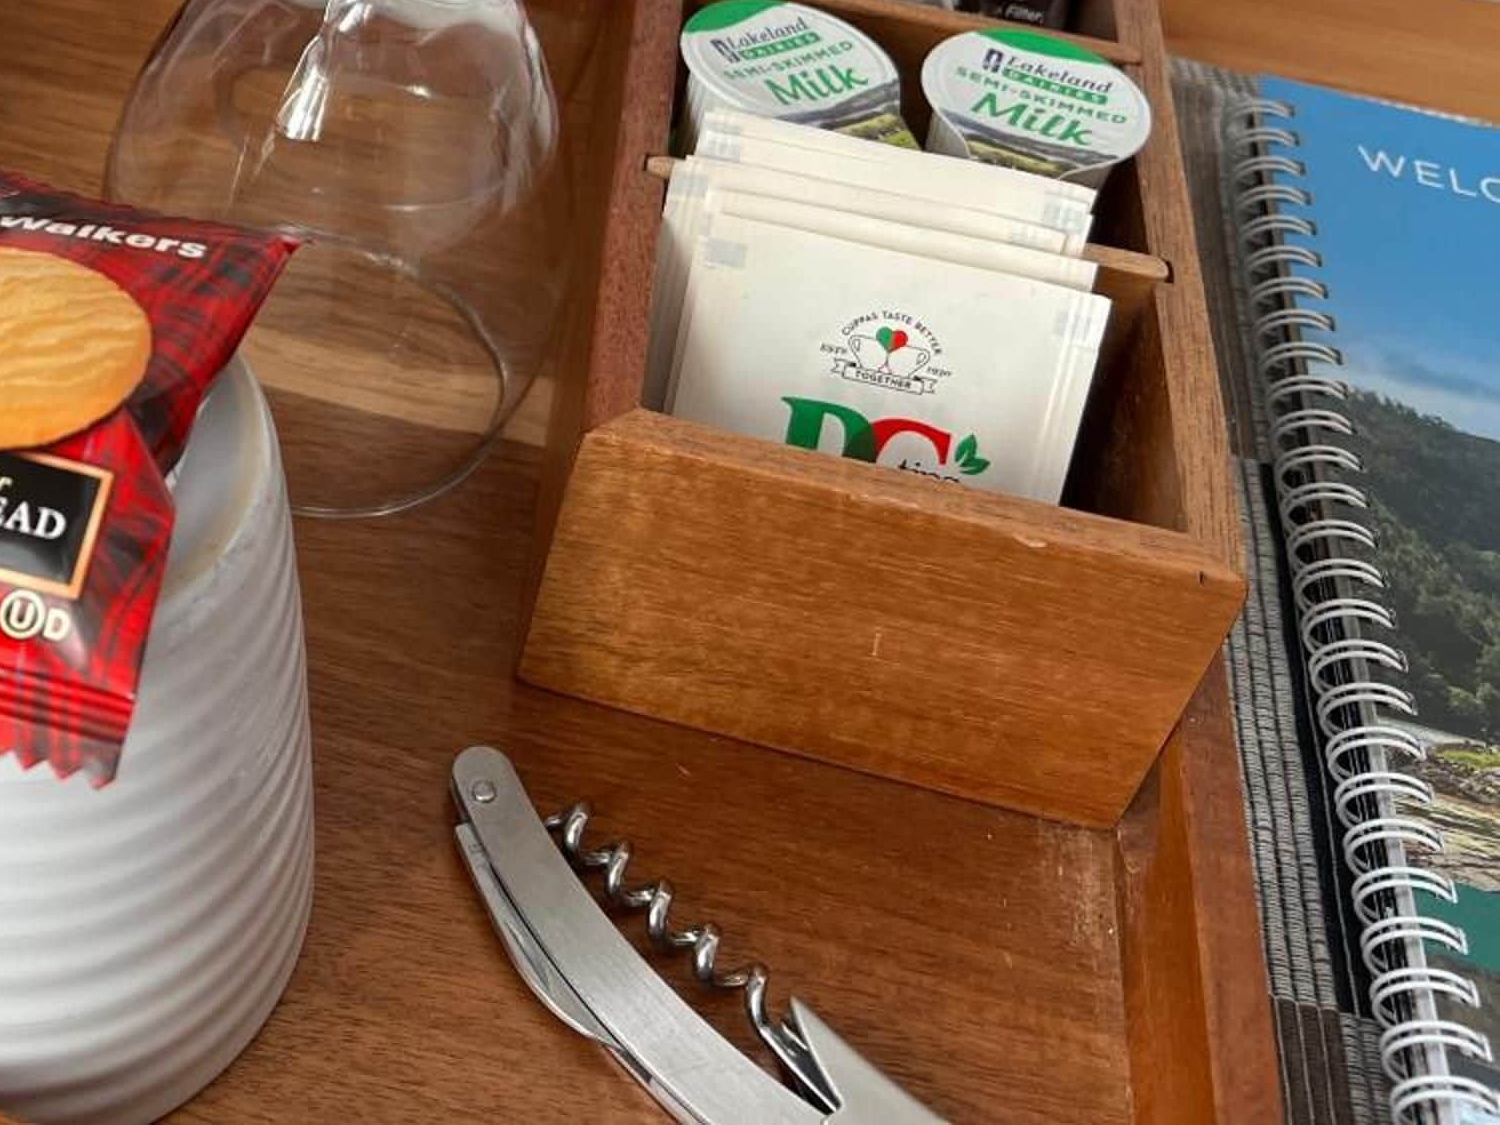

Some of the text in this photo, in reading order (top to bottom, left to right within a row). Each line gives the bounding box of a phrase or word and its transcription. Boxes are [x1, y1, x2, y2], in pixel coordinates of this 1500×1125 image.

[726, 16, 809, 49] Lakeland
[764, 64, 868, 106] Milk
[955, 66, 1127, 124] SEMI-SKIMMED
[1006, 56, 1113, 93] Lakeland
[971, 92, 1093, 146] Milk
[0, 215, 208, 259] Walkers
[881, 310, 913, 325] TASTE
[913, 321, 943, 355] BETTER
[855, 370, 912, 389] TOGETHER
